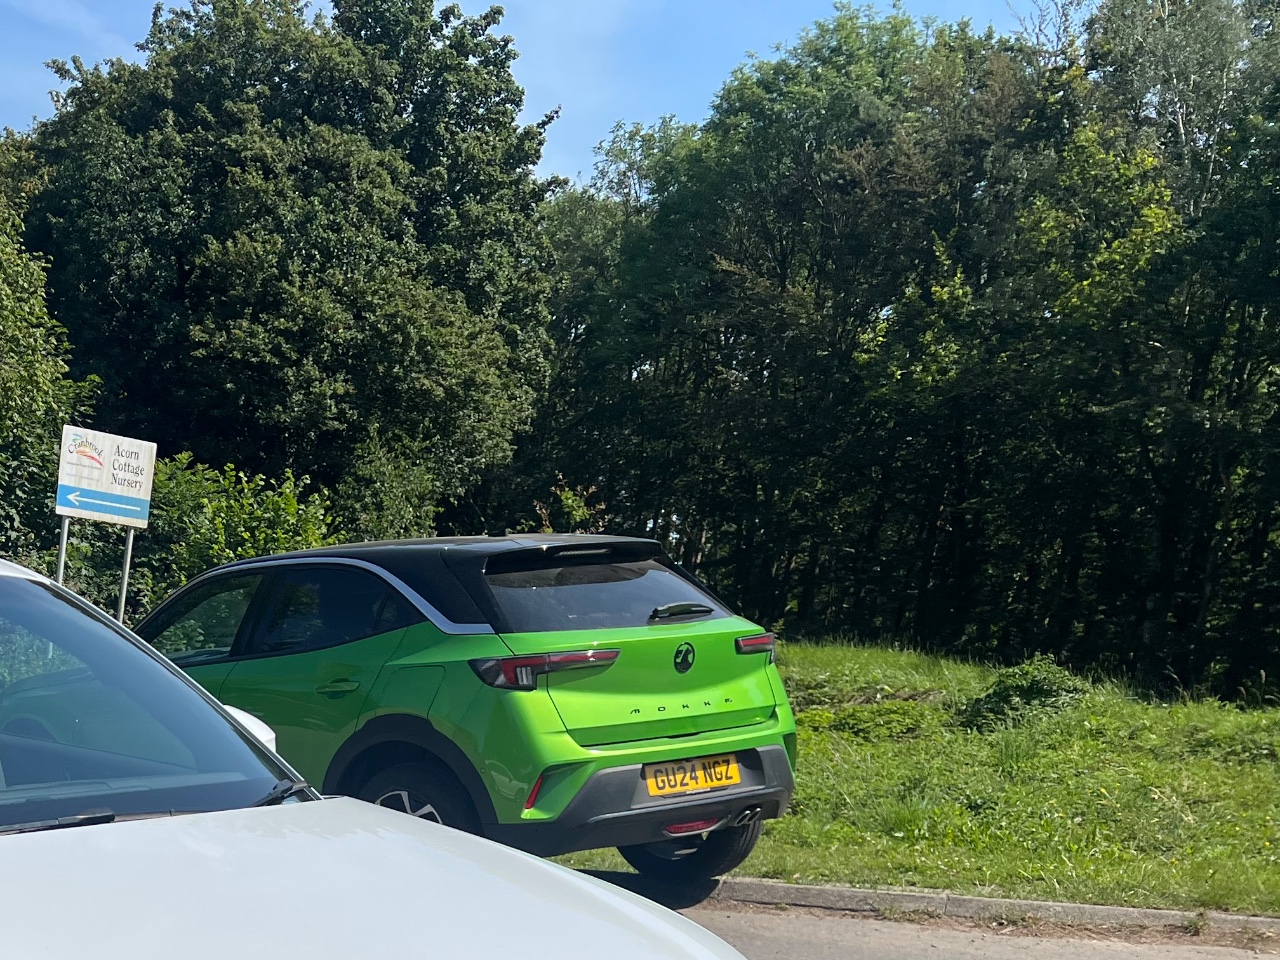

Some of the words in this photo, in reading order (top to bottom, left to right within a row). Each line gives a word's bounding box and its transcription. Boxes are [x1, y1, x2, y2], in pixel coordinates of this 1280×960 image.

[114, 444, 140, 460] Acorn
[112, 458, 145, 477] Cottage
[111, 472, 143, 491] Nursery
[653, 763, 699, 791] GU24
[702, 758, 734, 784] NGZ
